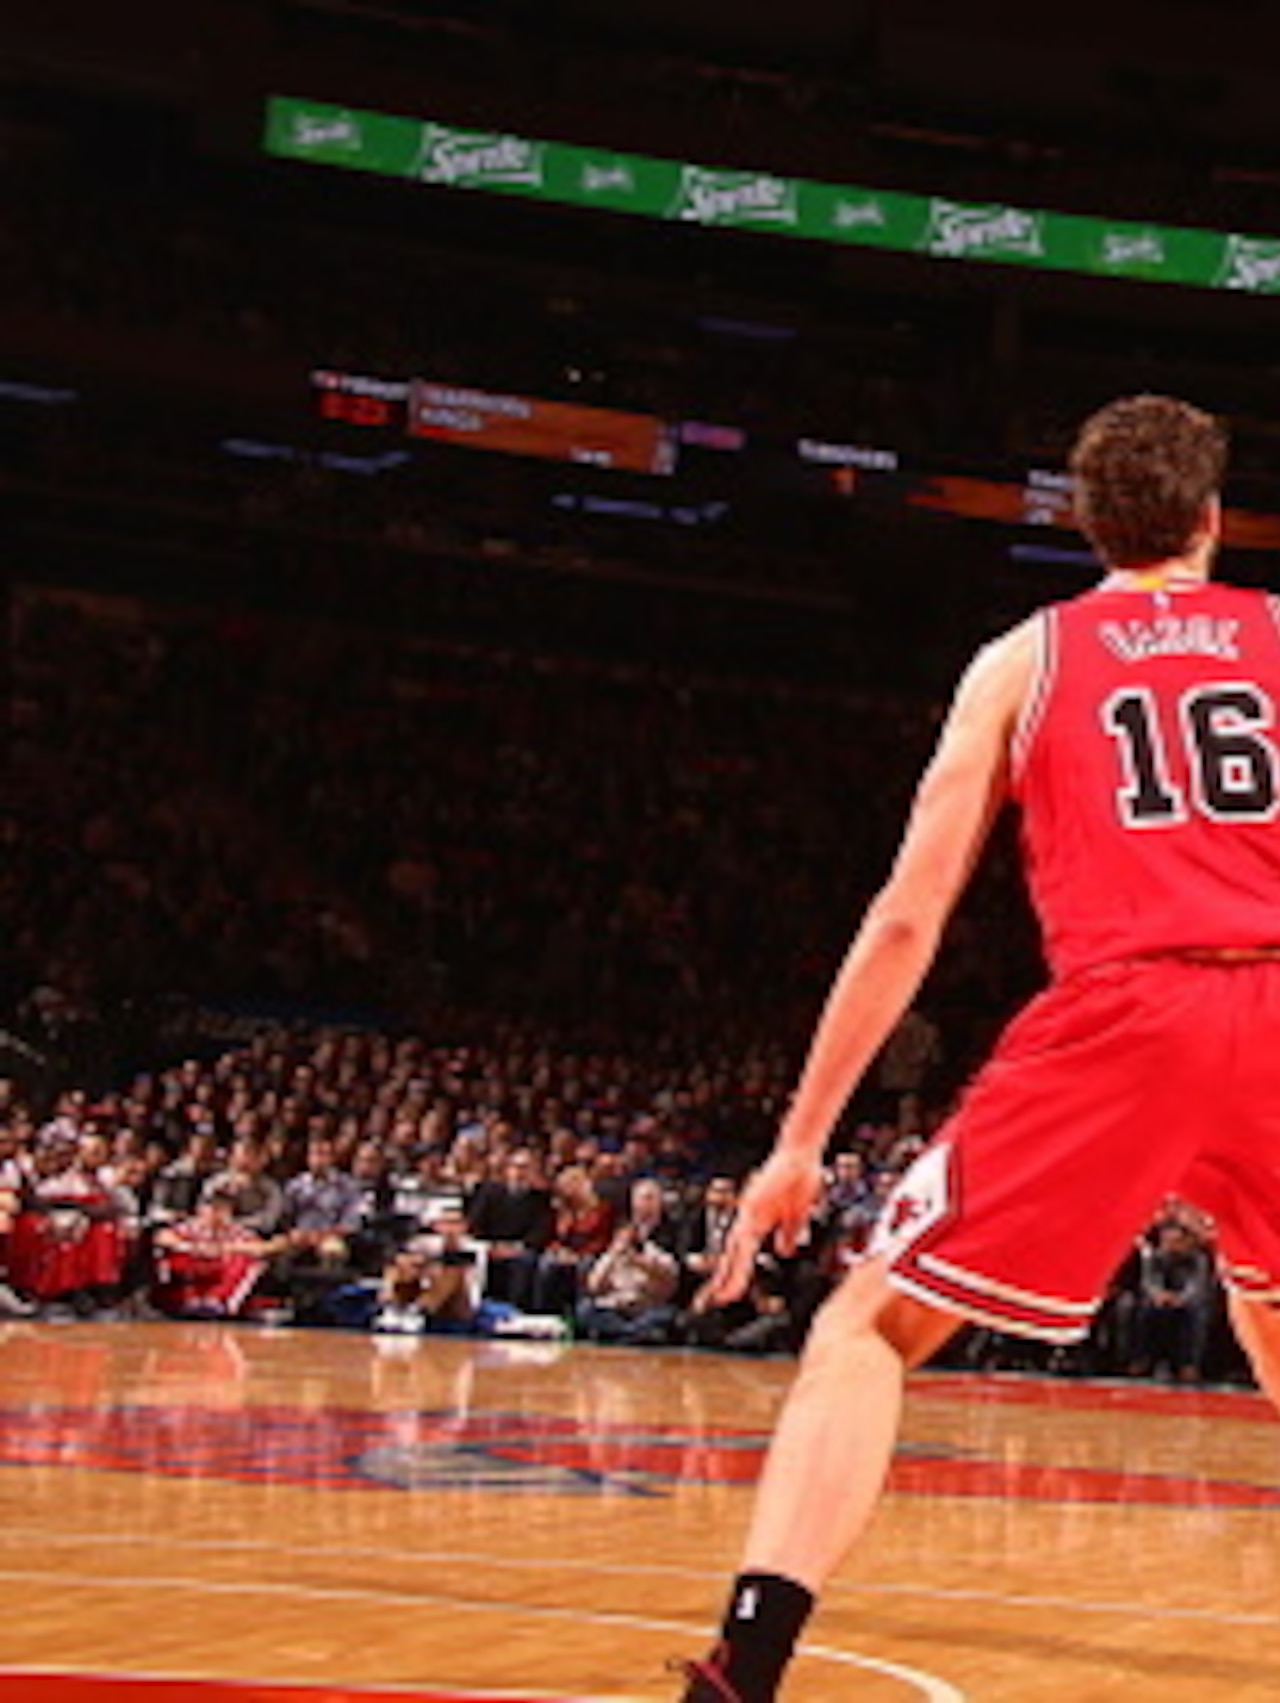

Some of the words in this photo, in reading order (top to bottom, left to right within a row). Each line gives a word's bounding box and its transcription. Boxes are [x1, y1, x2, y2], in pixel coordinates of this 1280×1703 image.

[431, 134, 533, 184] Sprite
[686, 175, 787, 225] Sprite
[940, 206, 1036, 257] Sprite
